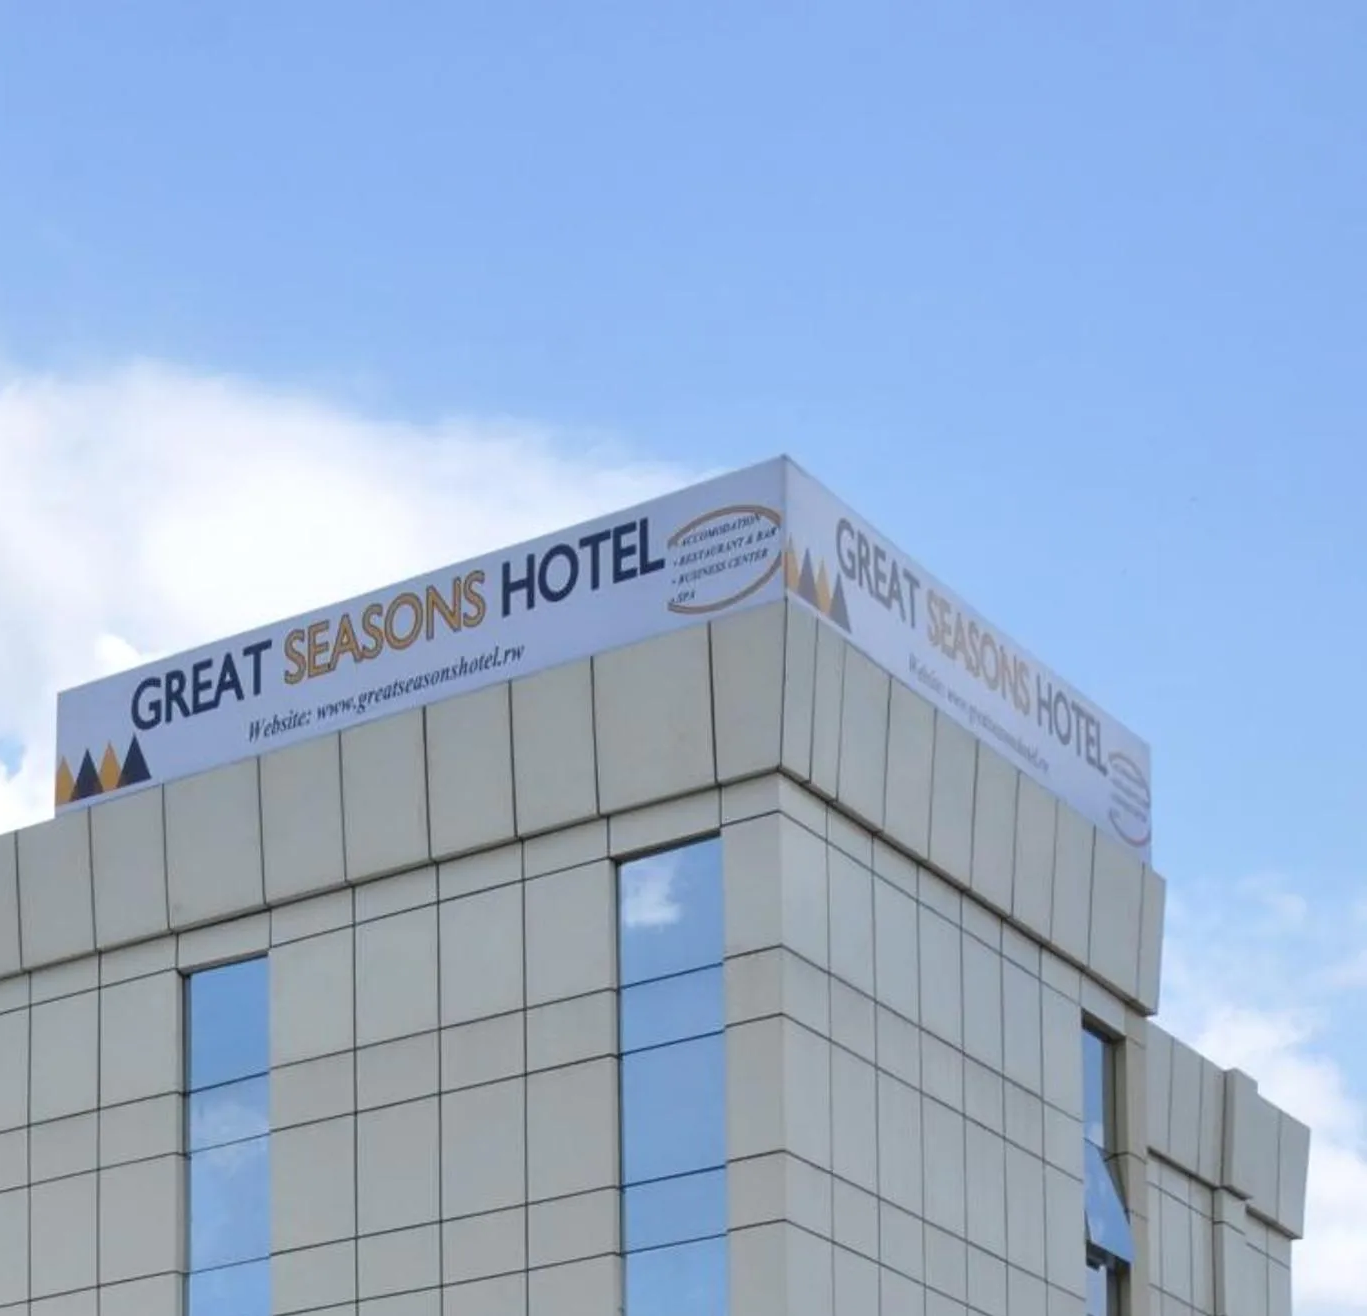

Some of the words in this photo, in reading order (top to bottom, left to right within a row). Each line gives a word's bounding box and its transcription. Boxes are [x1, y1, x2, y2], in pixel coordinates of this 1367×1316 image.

[131, 639, 273, 731] GREAT
[284, 570, 486, 685] SEASONS
[501, 517, 665, 618] HOTEL
[248, 709, 311, 743] Website:
[317, 644, 526, 714] www.greatseasonshotel.rw
[835, 518, 921, 629] GREAT
[927, 587, 1031, 716] SEASONS
[1036, 671, 1108, 777] HOTEL
